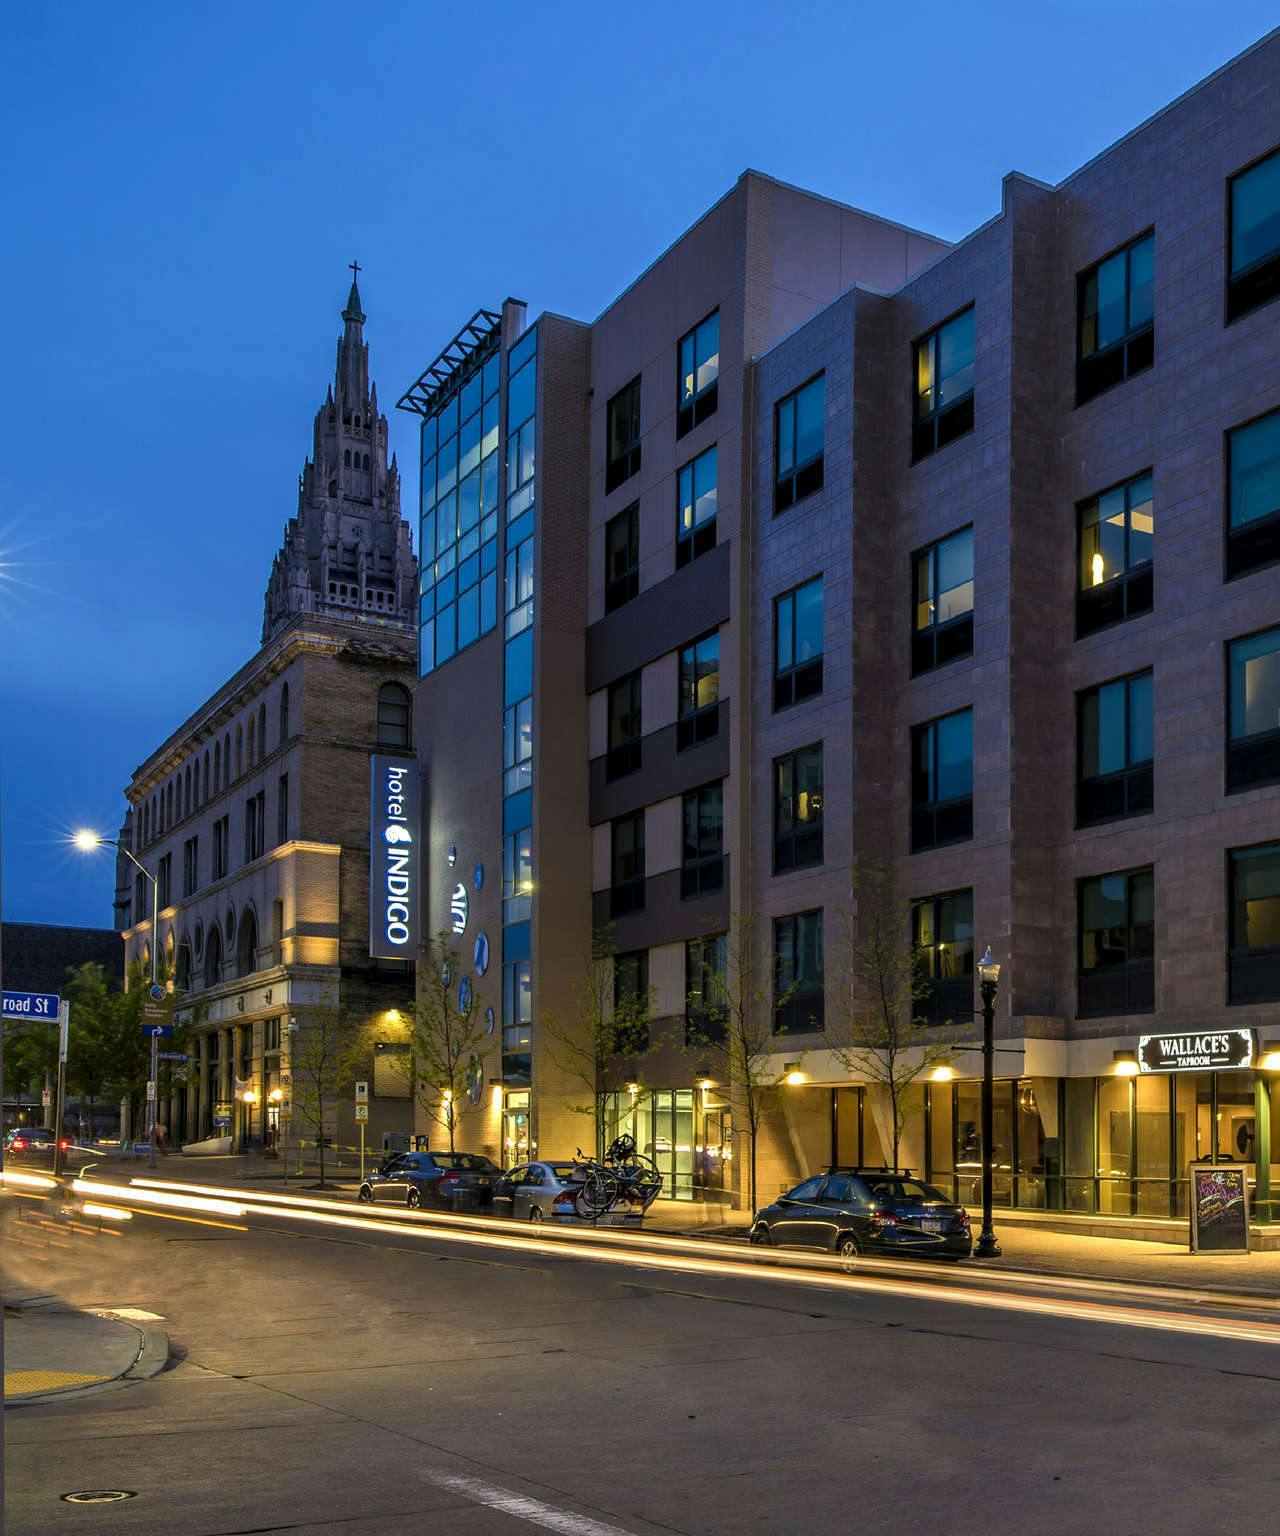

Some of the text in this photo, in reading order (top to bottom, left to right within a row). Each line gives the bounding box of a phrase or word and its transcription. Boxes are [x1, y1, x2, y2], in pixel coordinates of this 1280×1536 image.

[387, 767, 410, 945] hotel INDIGO
[35, 997, 49, 1013] St
[1159, 1035, 1229, 1056] WALLACE'S
[1177, 1056, 1210, 1067] TAPROOM
